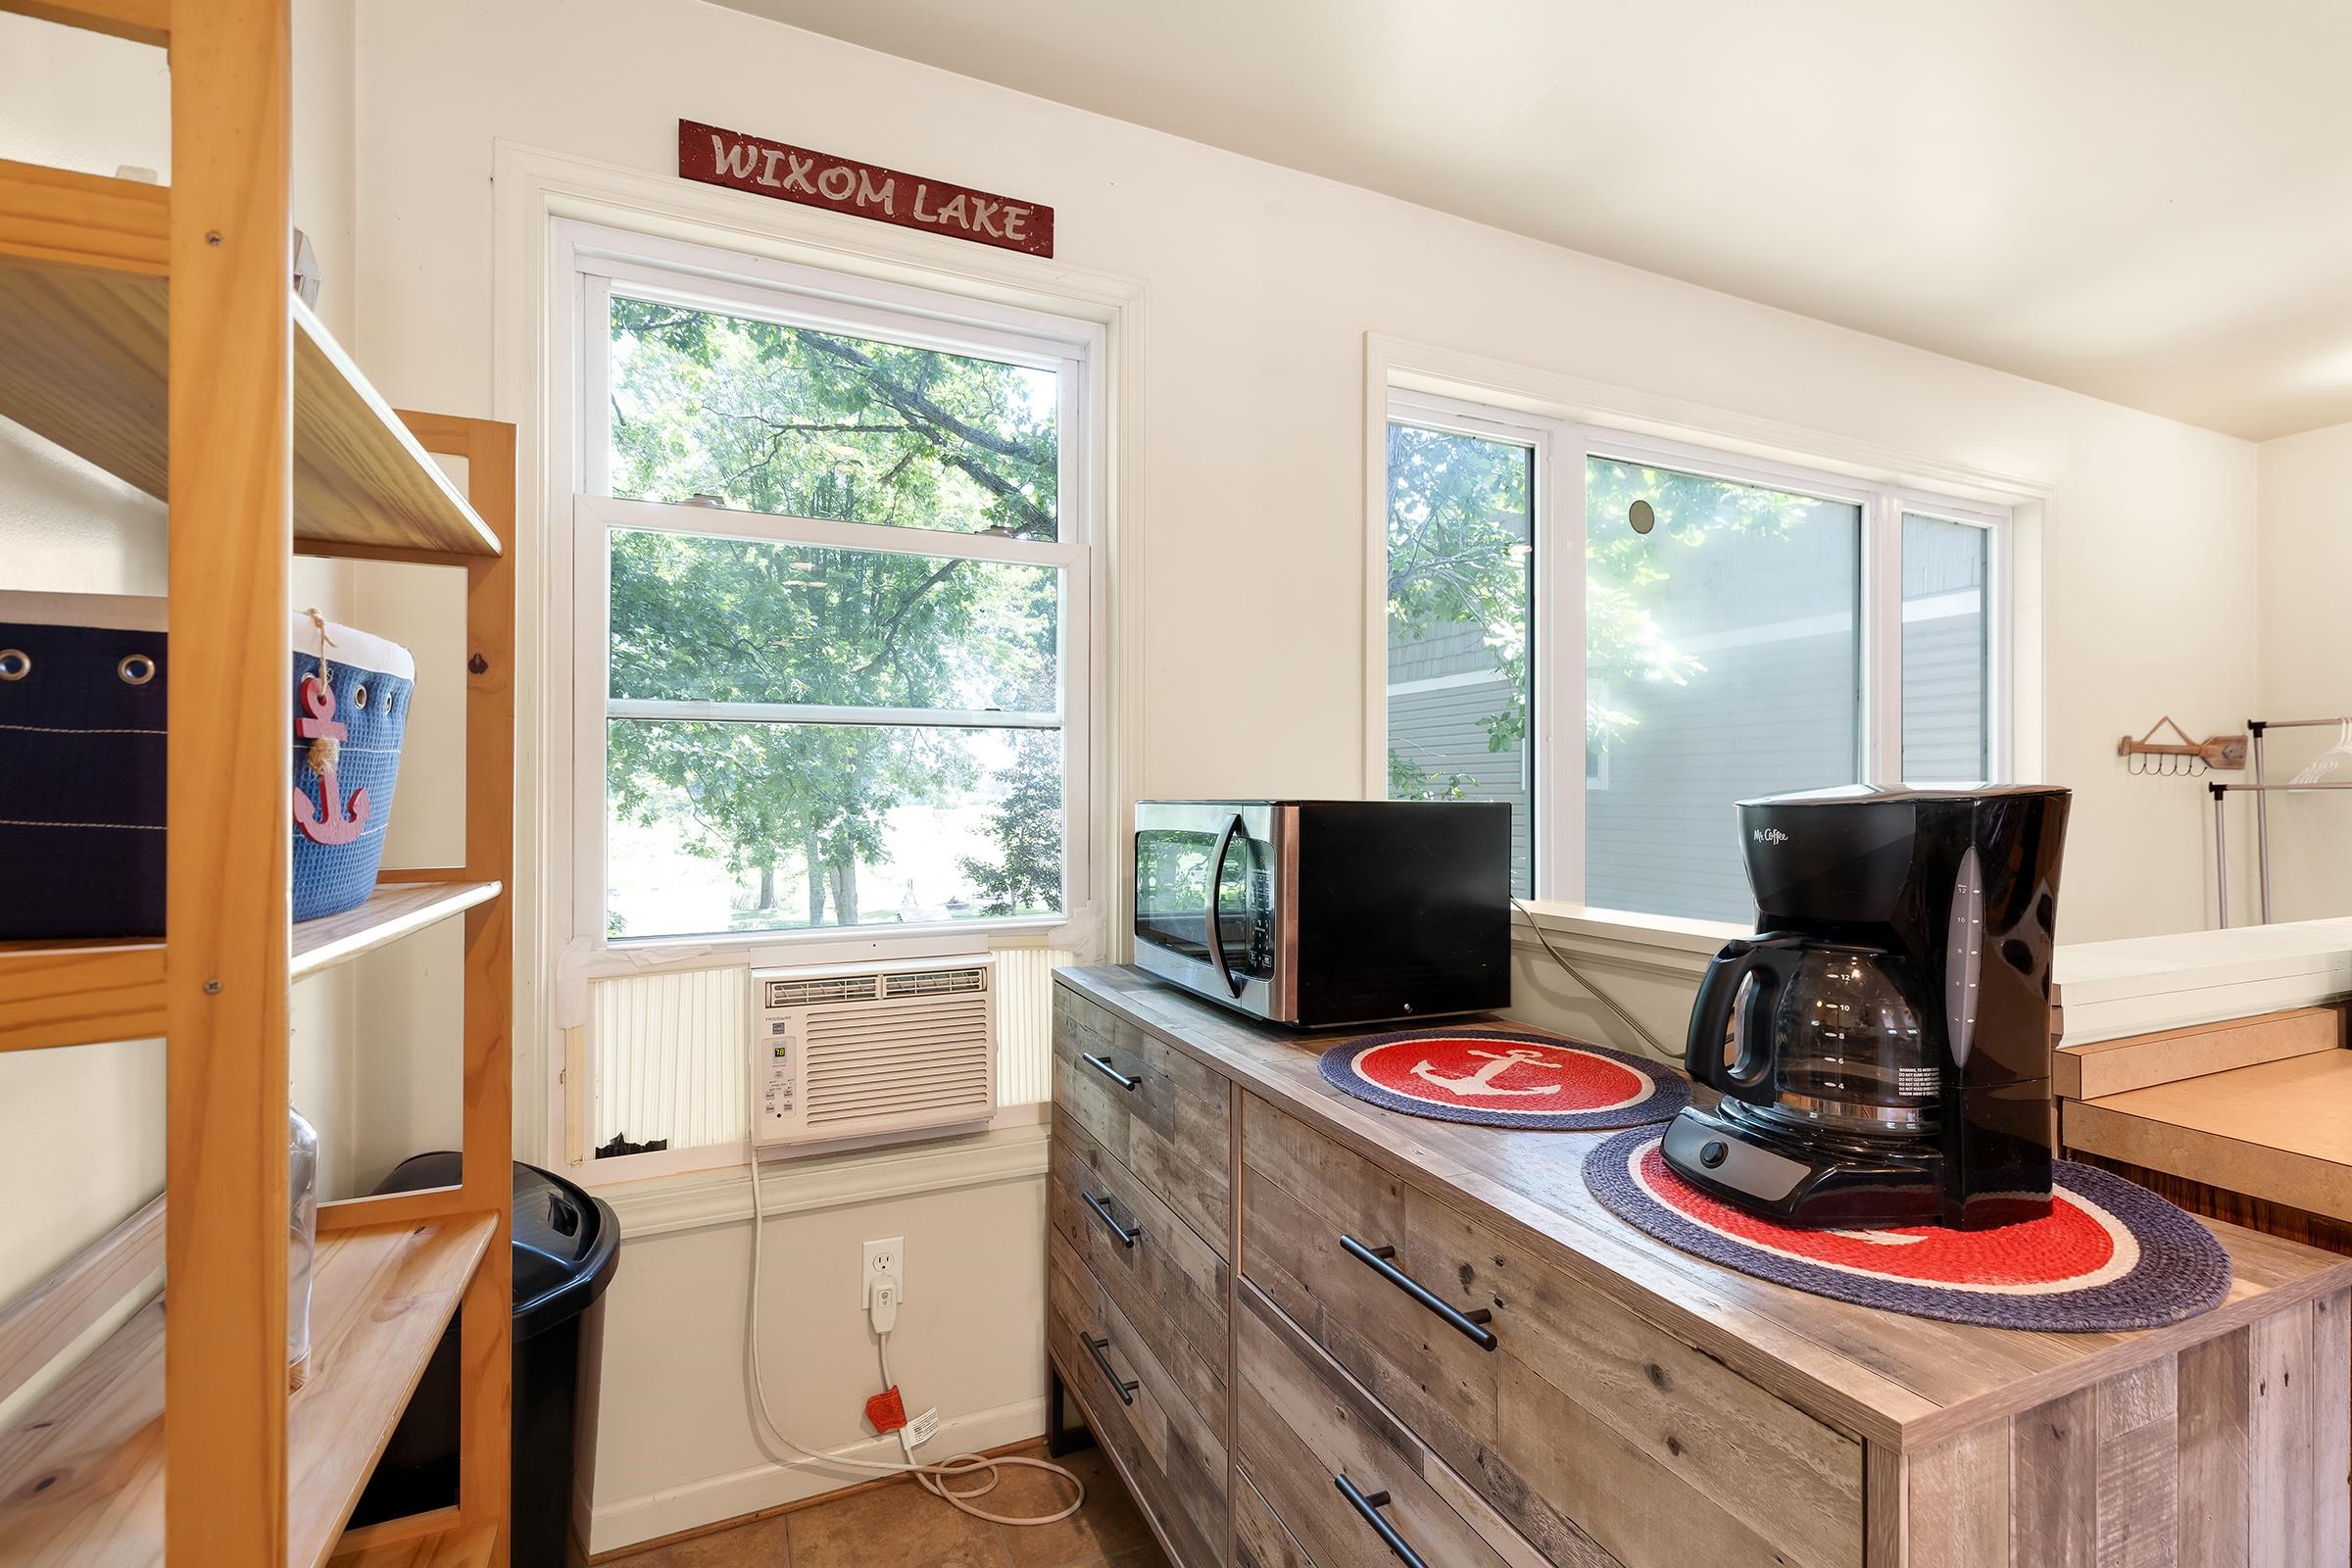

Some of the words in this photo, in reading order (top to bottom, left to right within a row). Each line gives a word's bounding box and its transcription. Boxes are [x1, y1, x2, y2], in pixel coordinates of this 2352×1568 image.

[710, 134, 896, 217] WIXOM
[913, 183, 1031, 241] LAKE
[1764, 828, 1788, 845] Coffee
